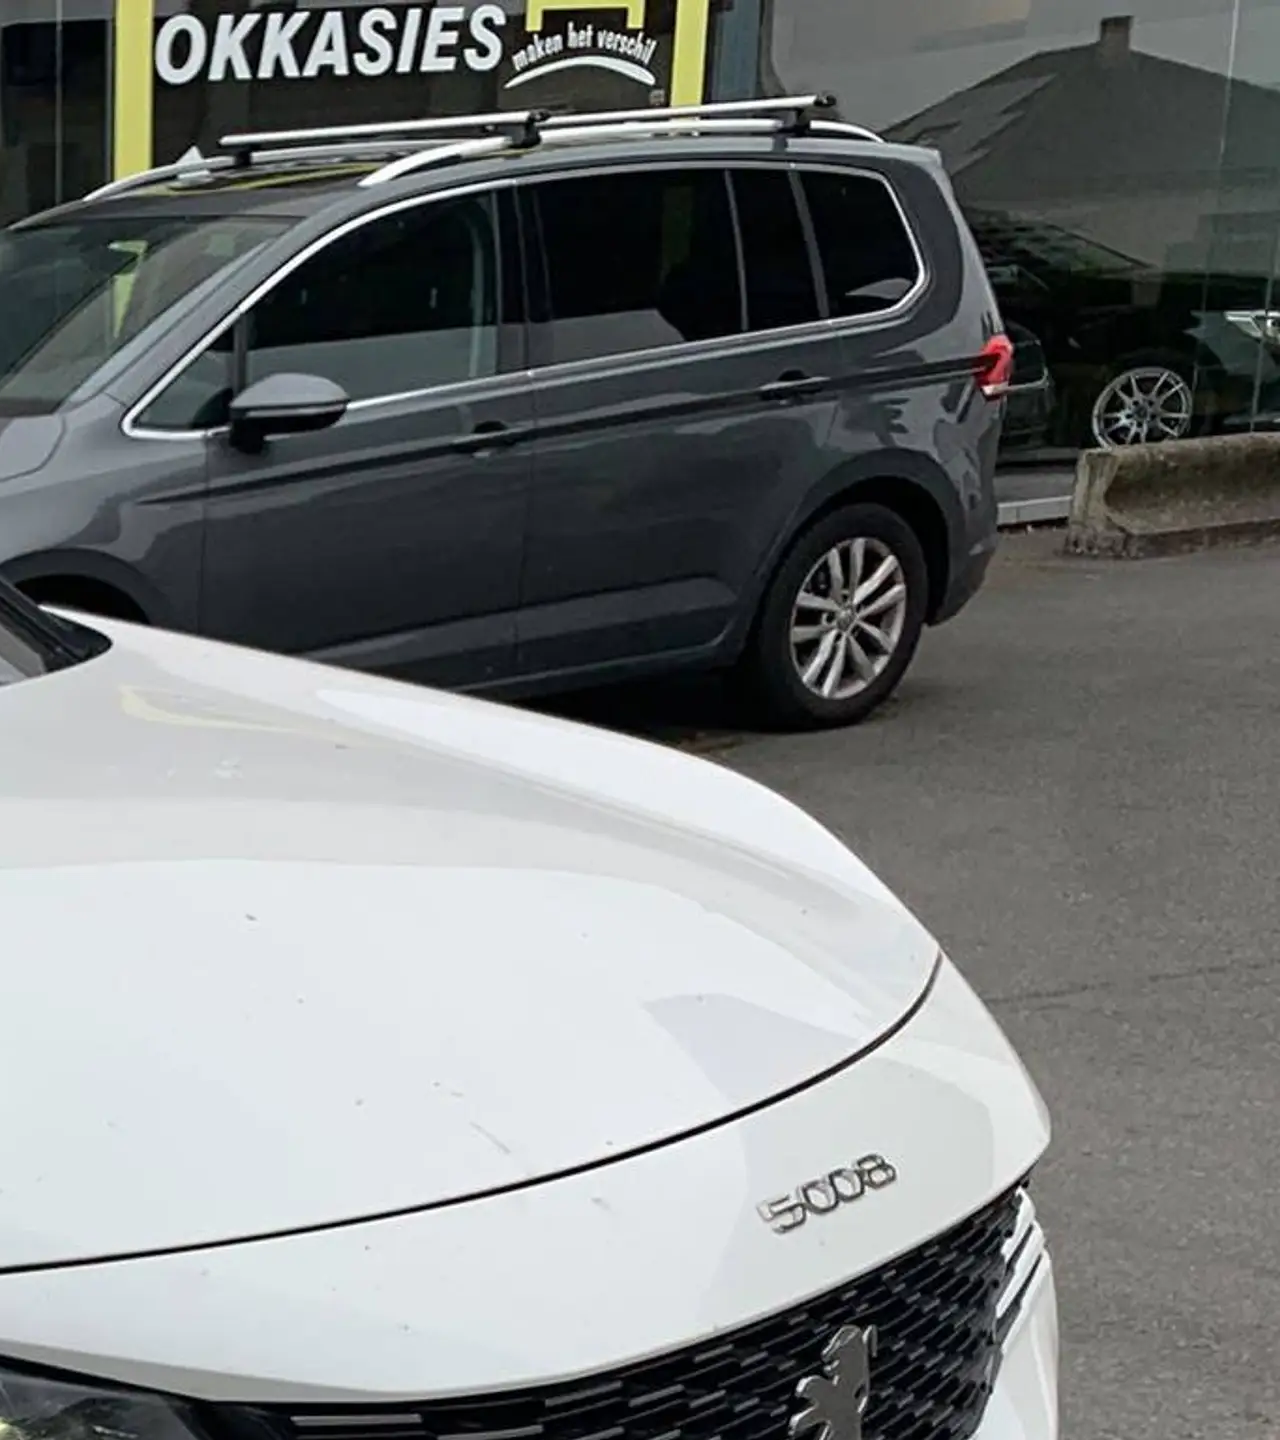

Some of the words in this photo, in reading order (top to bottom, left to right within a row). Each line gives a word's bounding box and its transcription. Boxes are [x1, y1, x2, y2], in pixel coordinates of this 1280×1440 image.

[154, 4, 507, 86] OKKASIES
[511, 33, 564, 71] maken
[567, 20, 594, 49] het
[596, 30, 657, 66] verschil
[755, 1152, 897, 1235] 5008
